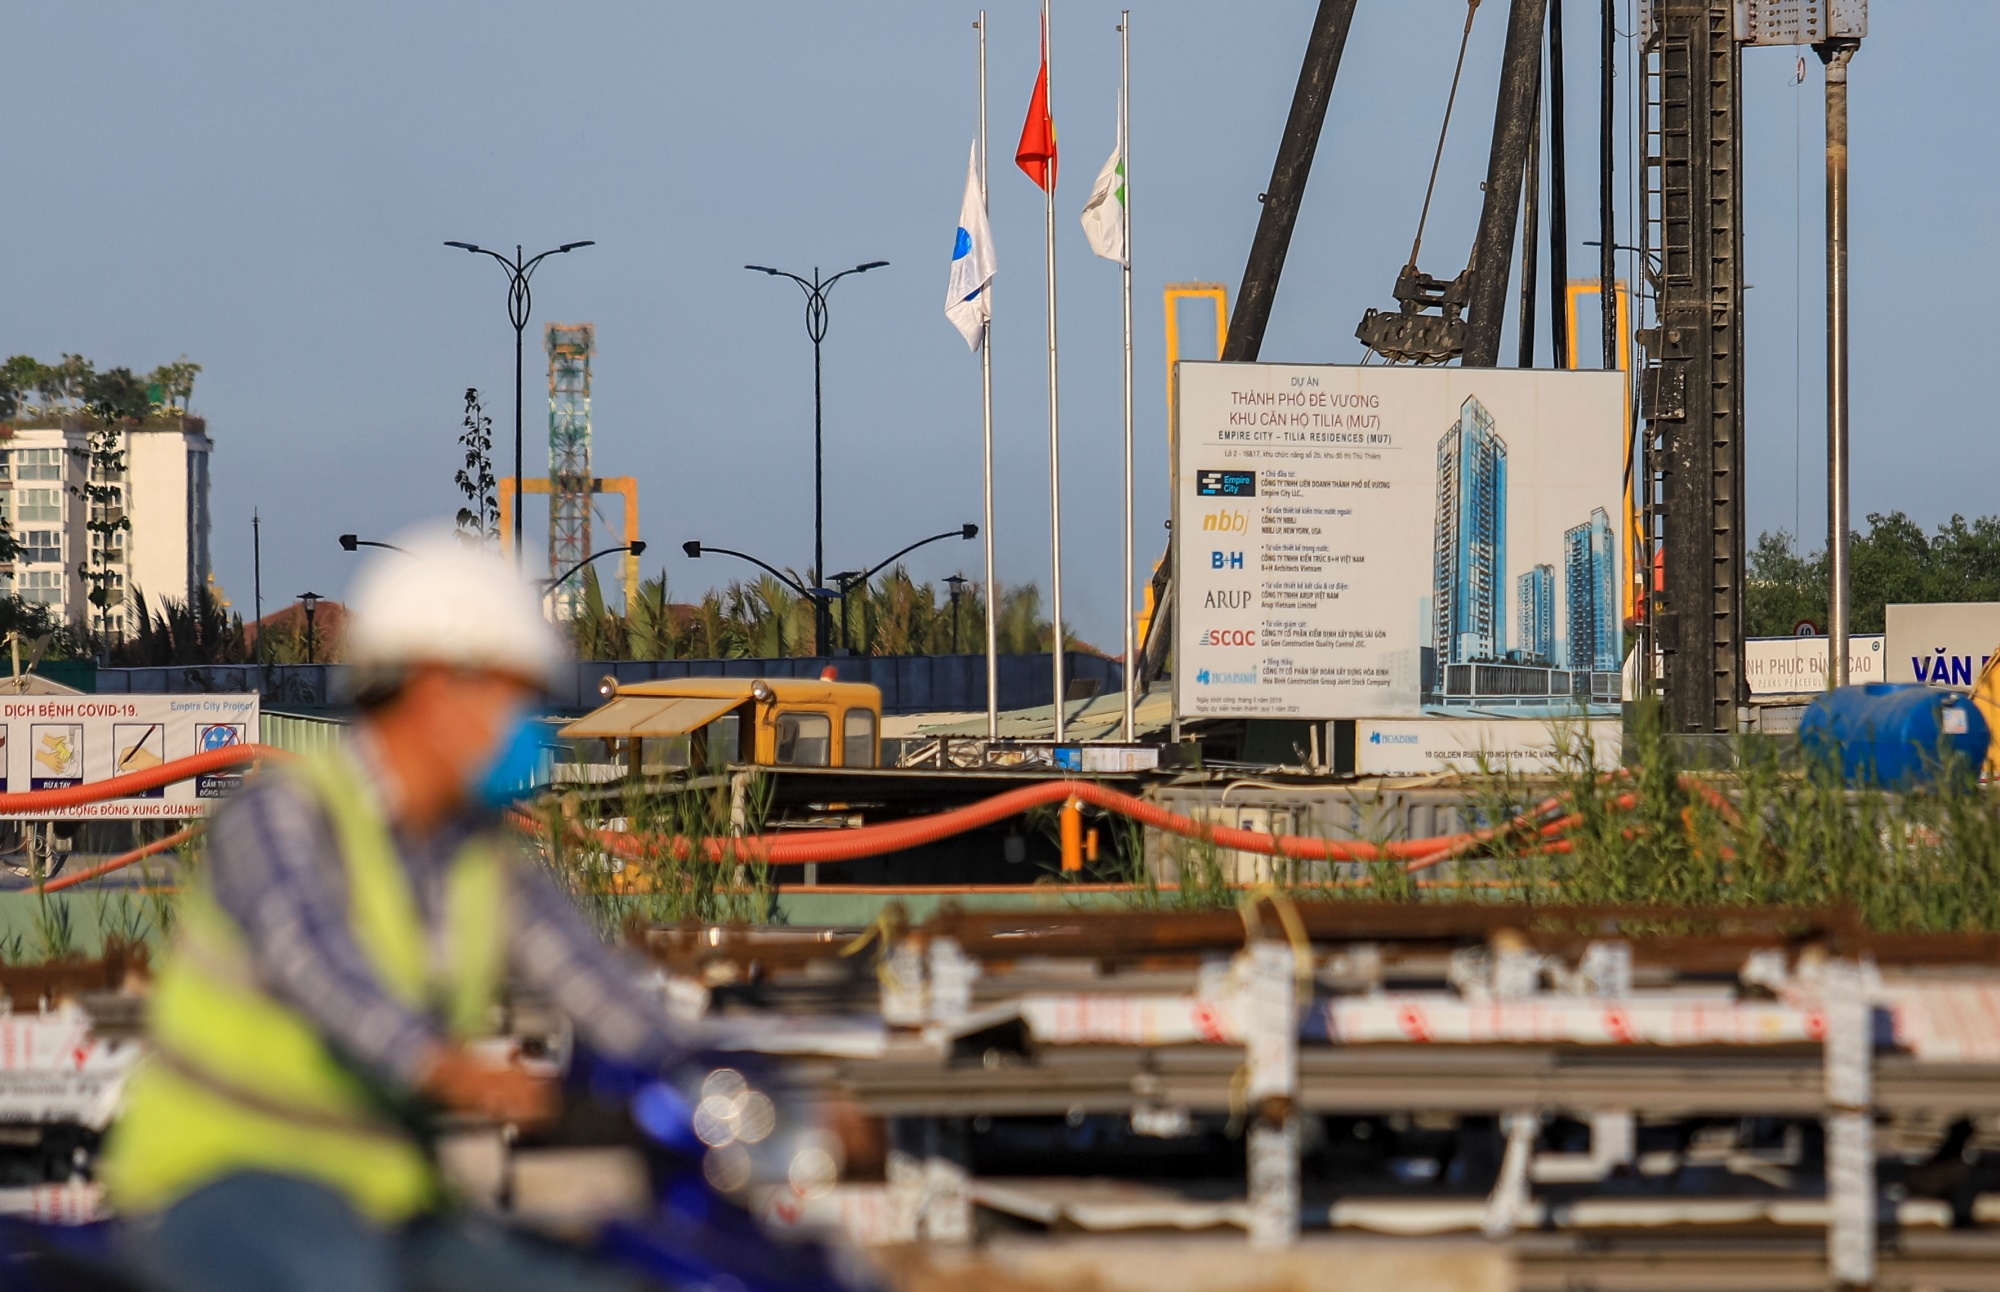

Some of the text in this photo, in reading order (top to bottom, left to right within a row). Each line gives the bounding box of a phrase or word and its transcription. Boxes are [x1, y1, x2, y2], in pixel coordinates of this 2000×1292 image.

[1291, 376, 1318, 387] DỰ ÁN
[1231, 389, 1379, 408] THÀNH PHỐ ĐẾ VƯƠNG
[1229, 411, 1380, 430] KHU CĂN HỘ TILIA (MU7)
[1218, 431, 1392, 444] EMPIRE CITY TILIA RESIDENCES (MU7)
[1224, 476, 1250, 486] Empire
[1224, 484, 1239, 494] City
[1261, 490, 1279, 498] Empire
[1280, 490, 1290, 498] City
[1203, 510, 1250, 536] nbbj
[1212, 551, 1244, 570] B+H
[1204, 590, 1251, 608] ARUP
[1849, 656, 1871, 672] CAO
[1911, 647, 1972, 686] VĂN
[1758, 678, 1781, 688] PEAKS
[4, 702, 138, 720] DỊCH BỆNH COVID-19.
[170, 701, 254, 712] Empire City Project
[101, 803, 129, 815] ĐỒNG
[133, 806, 160, 815] XUNG
